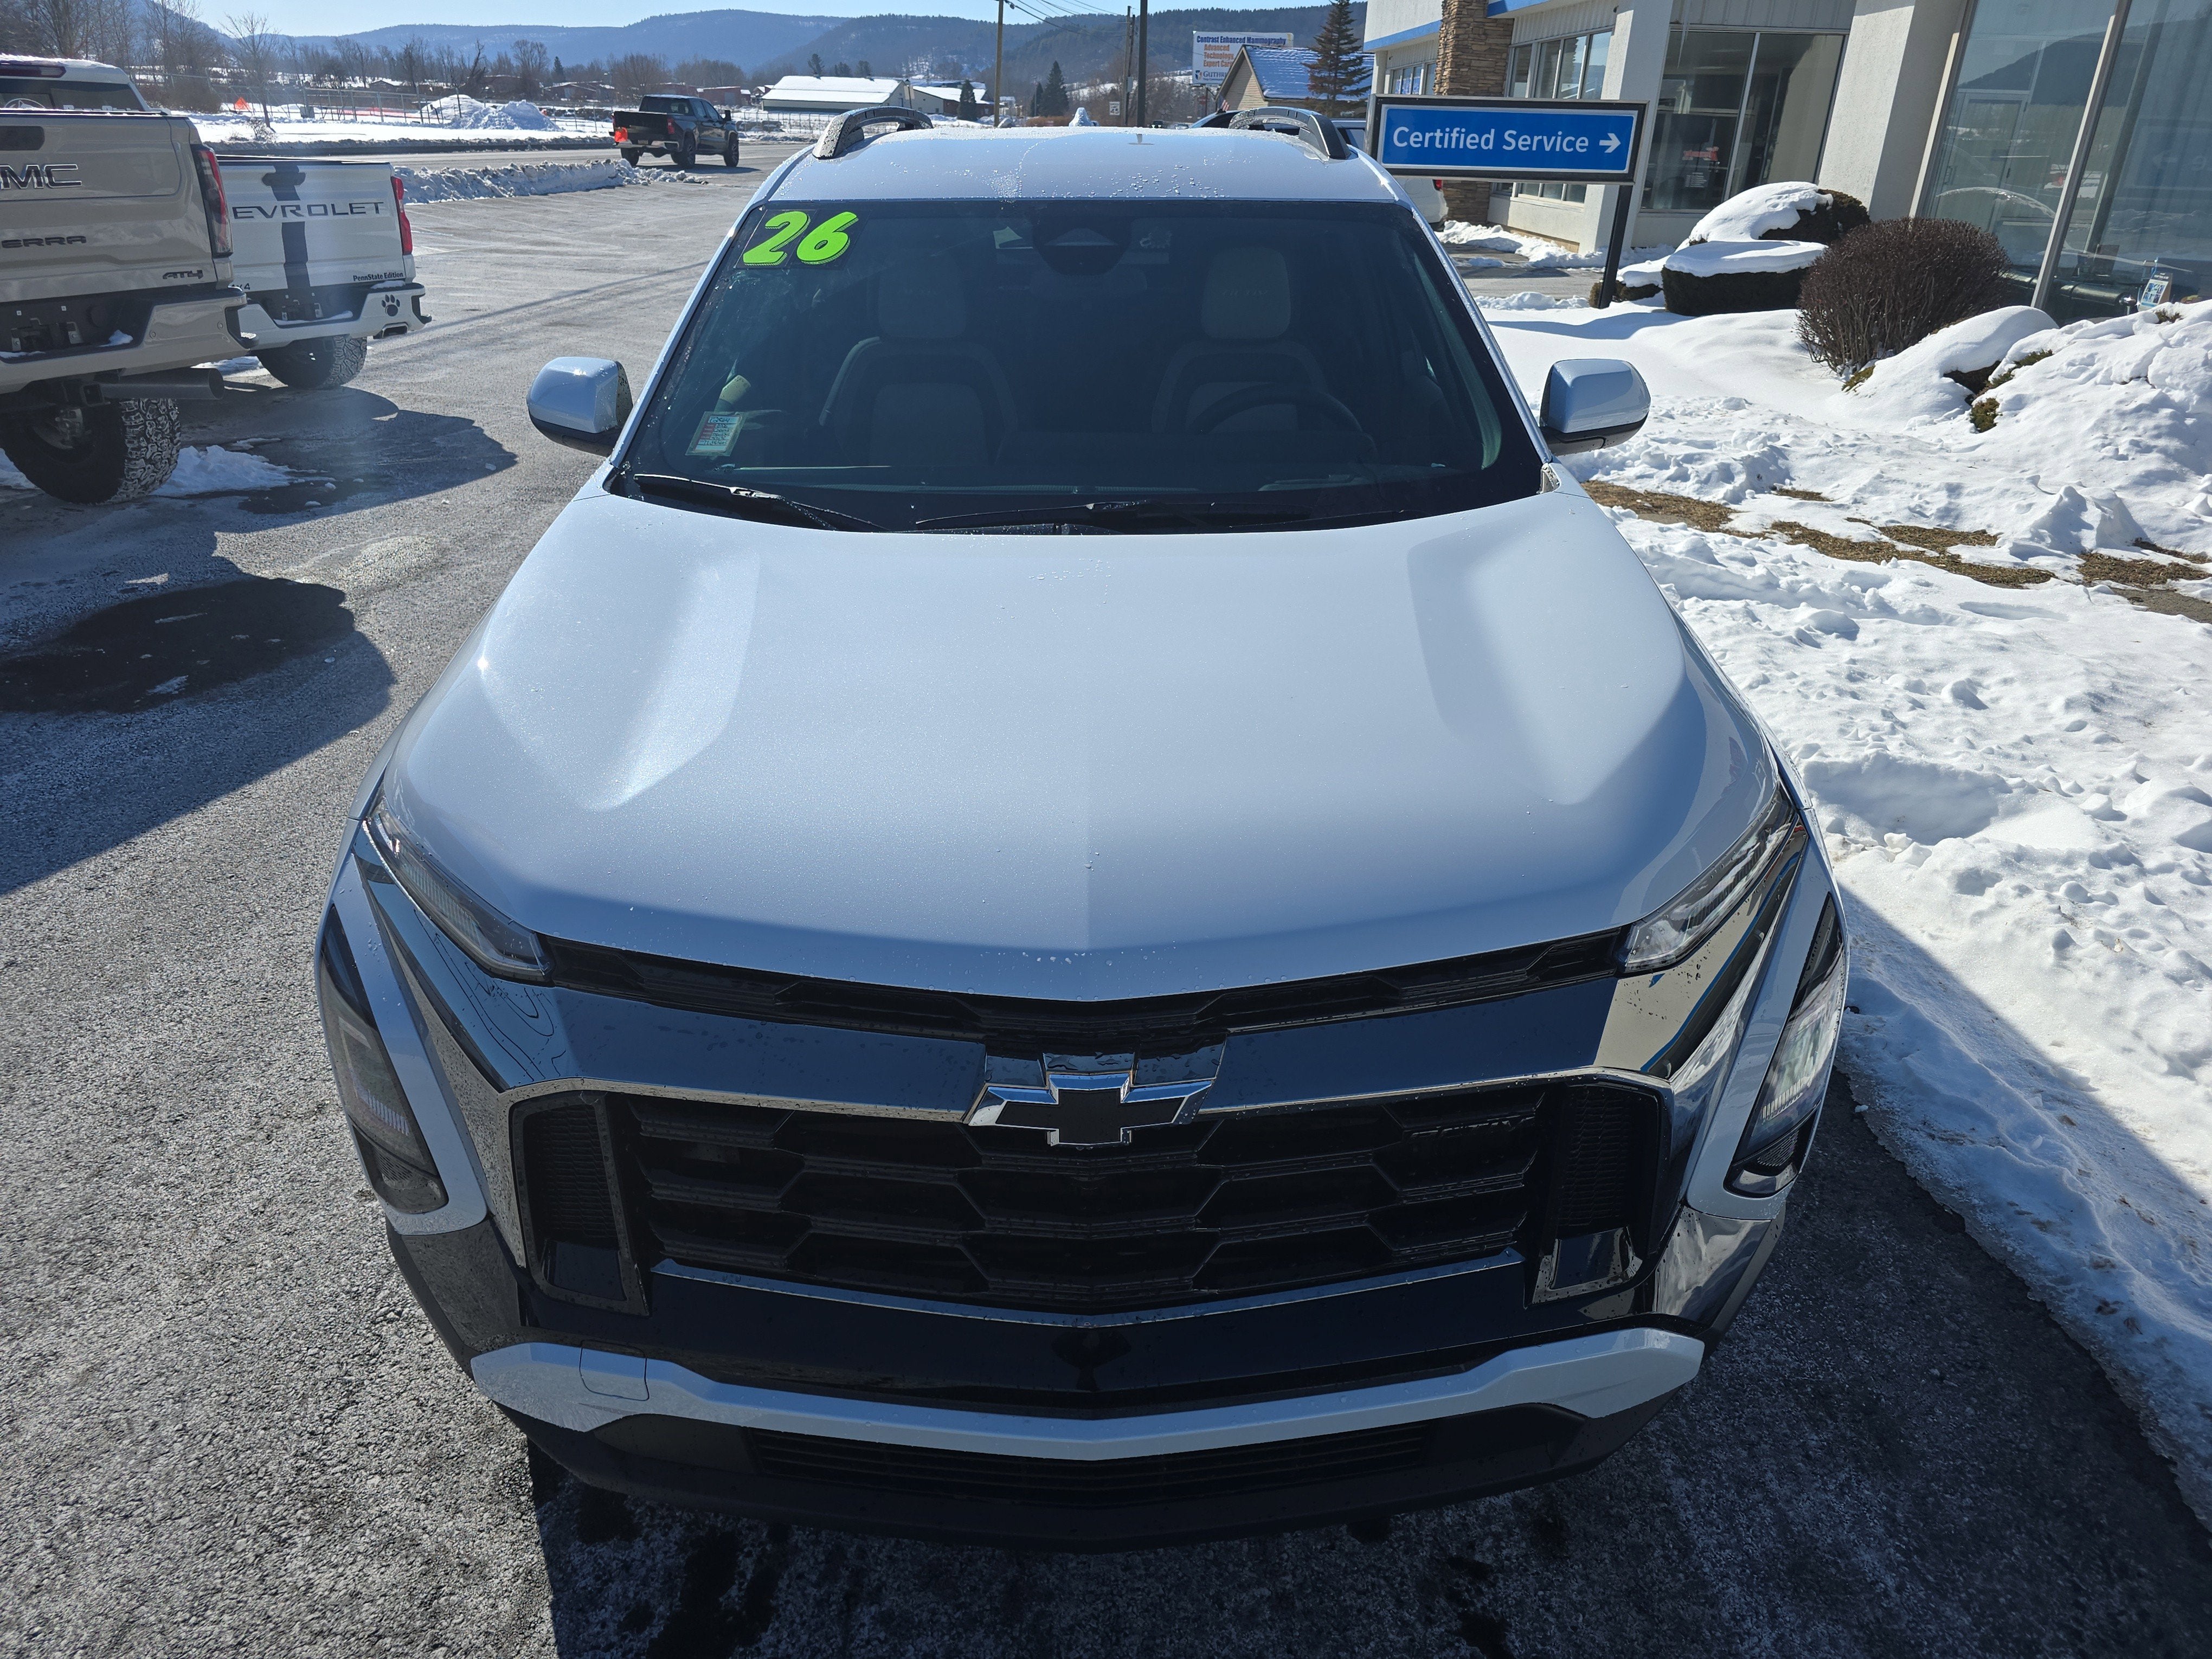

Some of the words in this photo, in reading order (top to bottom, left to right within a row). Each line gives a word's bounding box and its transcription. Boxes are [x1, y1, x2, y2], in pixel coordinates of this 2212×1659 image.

[1247, 36, 1287, 45] Mammography
[1393, 126, 1495, 150] Certified
[1502, 130, 1589, 152] Service
[232, 202, 384, 219] EVROLET
[743, 211, 859, 266] 26
[163, 269, 204, 280] AT4
